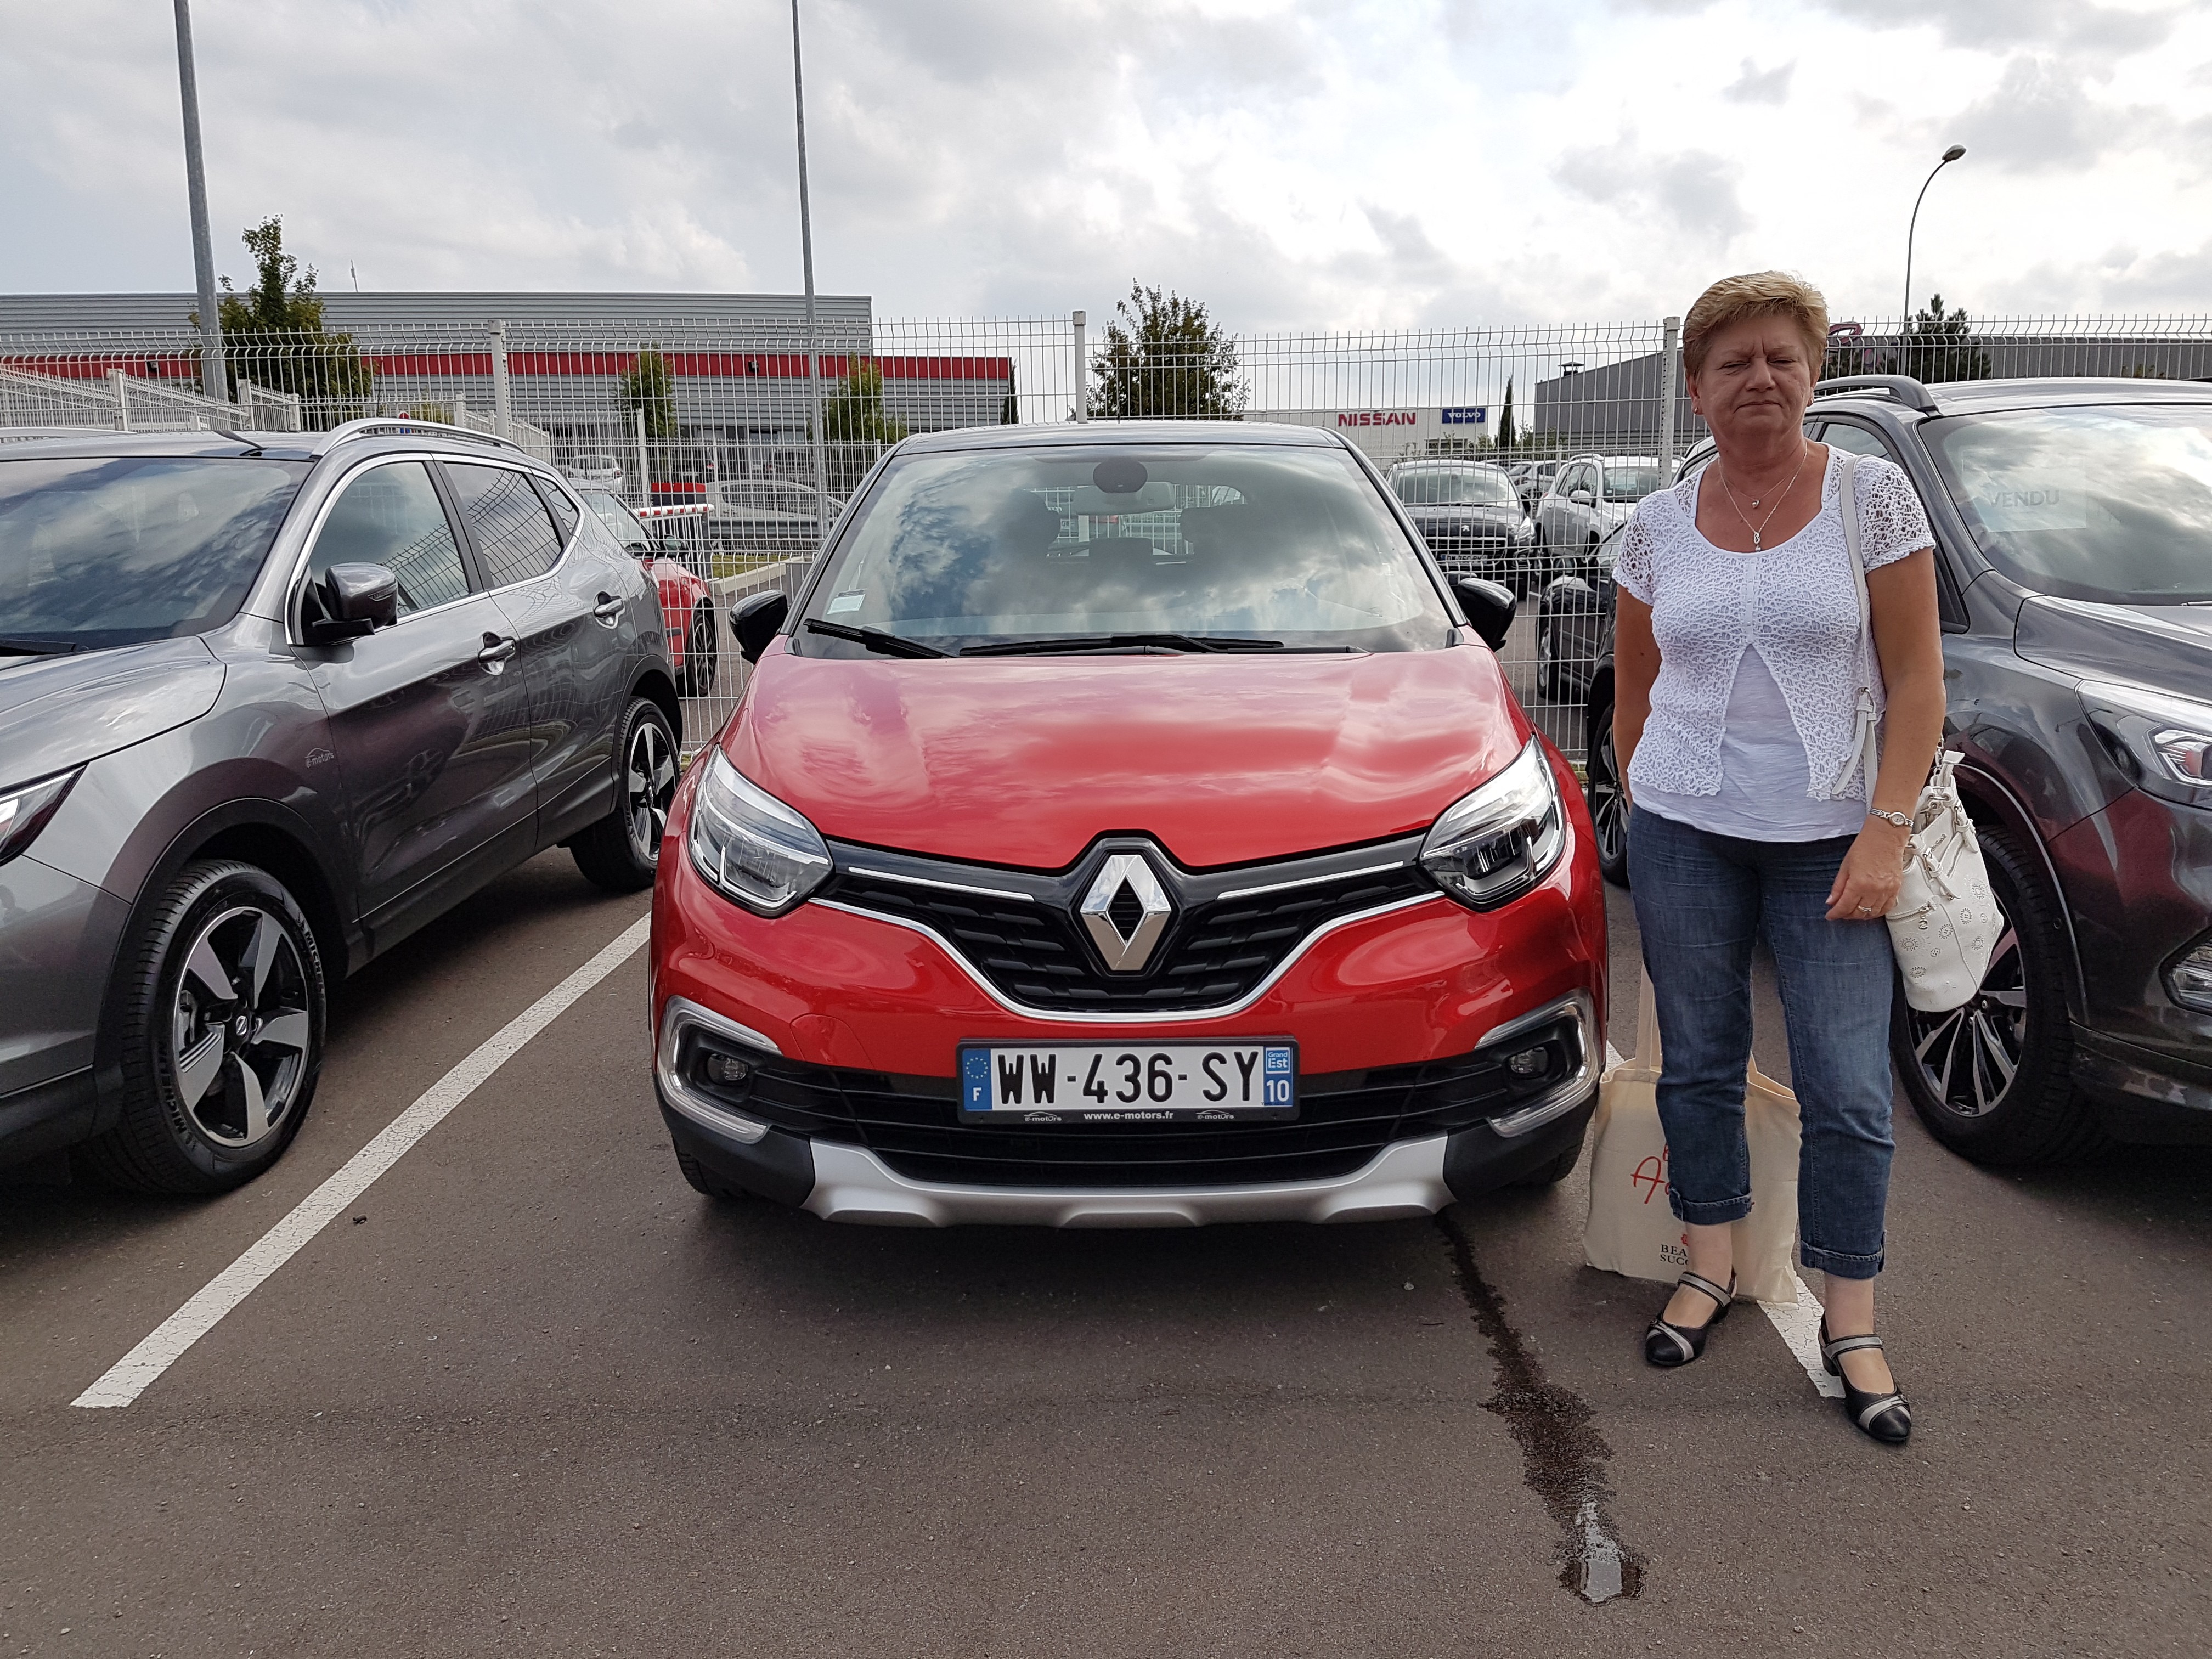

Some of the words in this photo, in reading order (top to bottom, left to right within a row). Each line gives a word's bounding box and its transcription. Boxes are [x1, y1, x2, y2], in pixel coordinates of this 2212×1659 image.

[1338, 412, 1416, 426] NISSAN
[1988, 489, 2059, 507] VENDU
[1268, 1058, 1288, 1068] Est
[973, 1087, 982, 1101] F
[1267, 1080, 1289, 1102] 10
[1084, 1111, 1173, 1120] www.e-motors.fr
[1661, 1244, 1688, 1257] BEA
